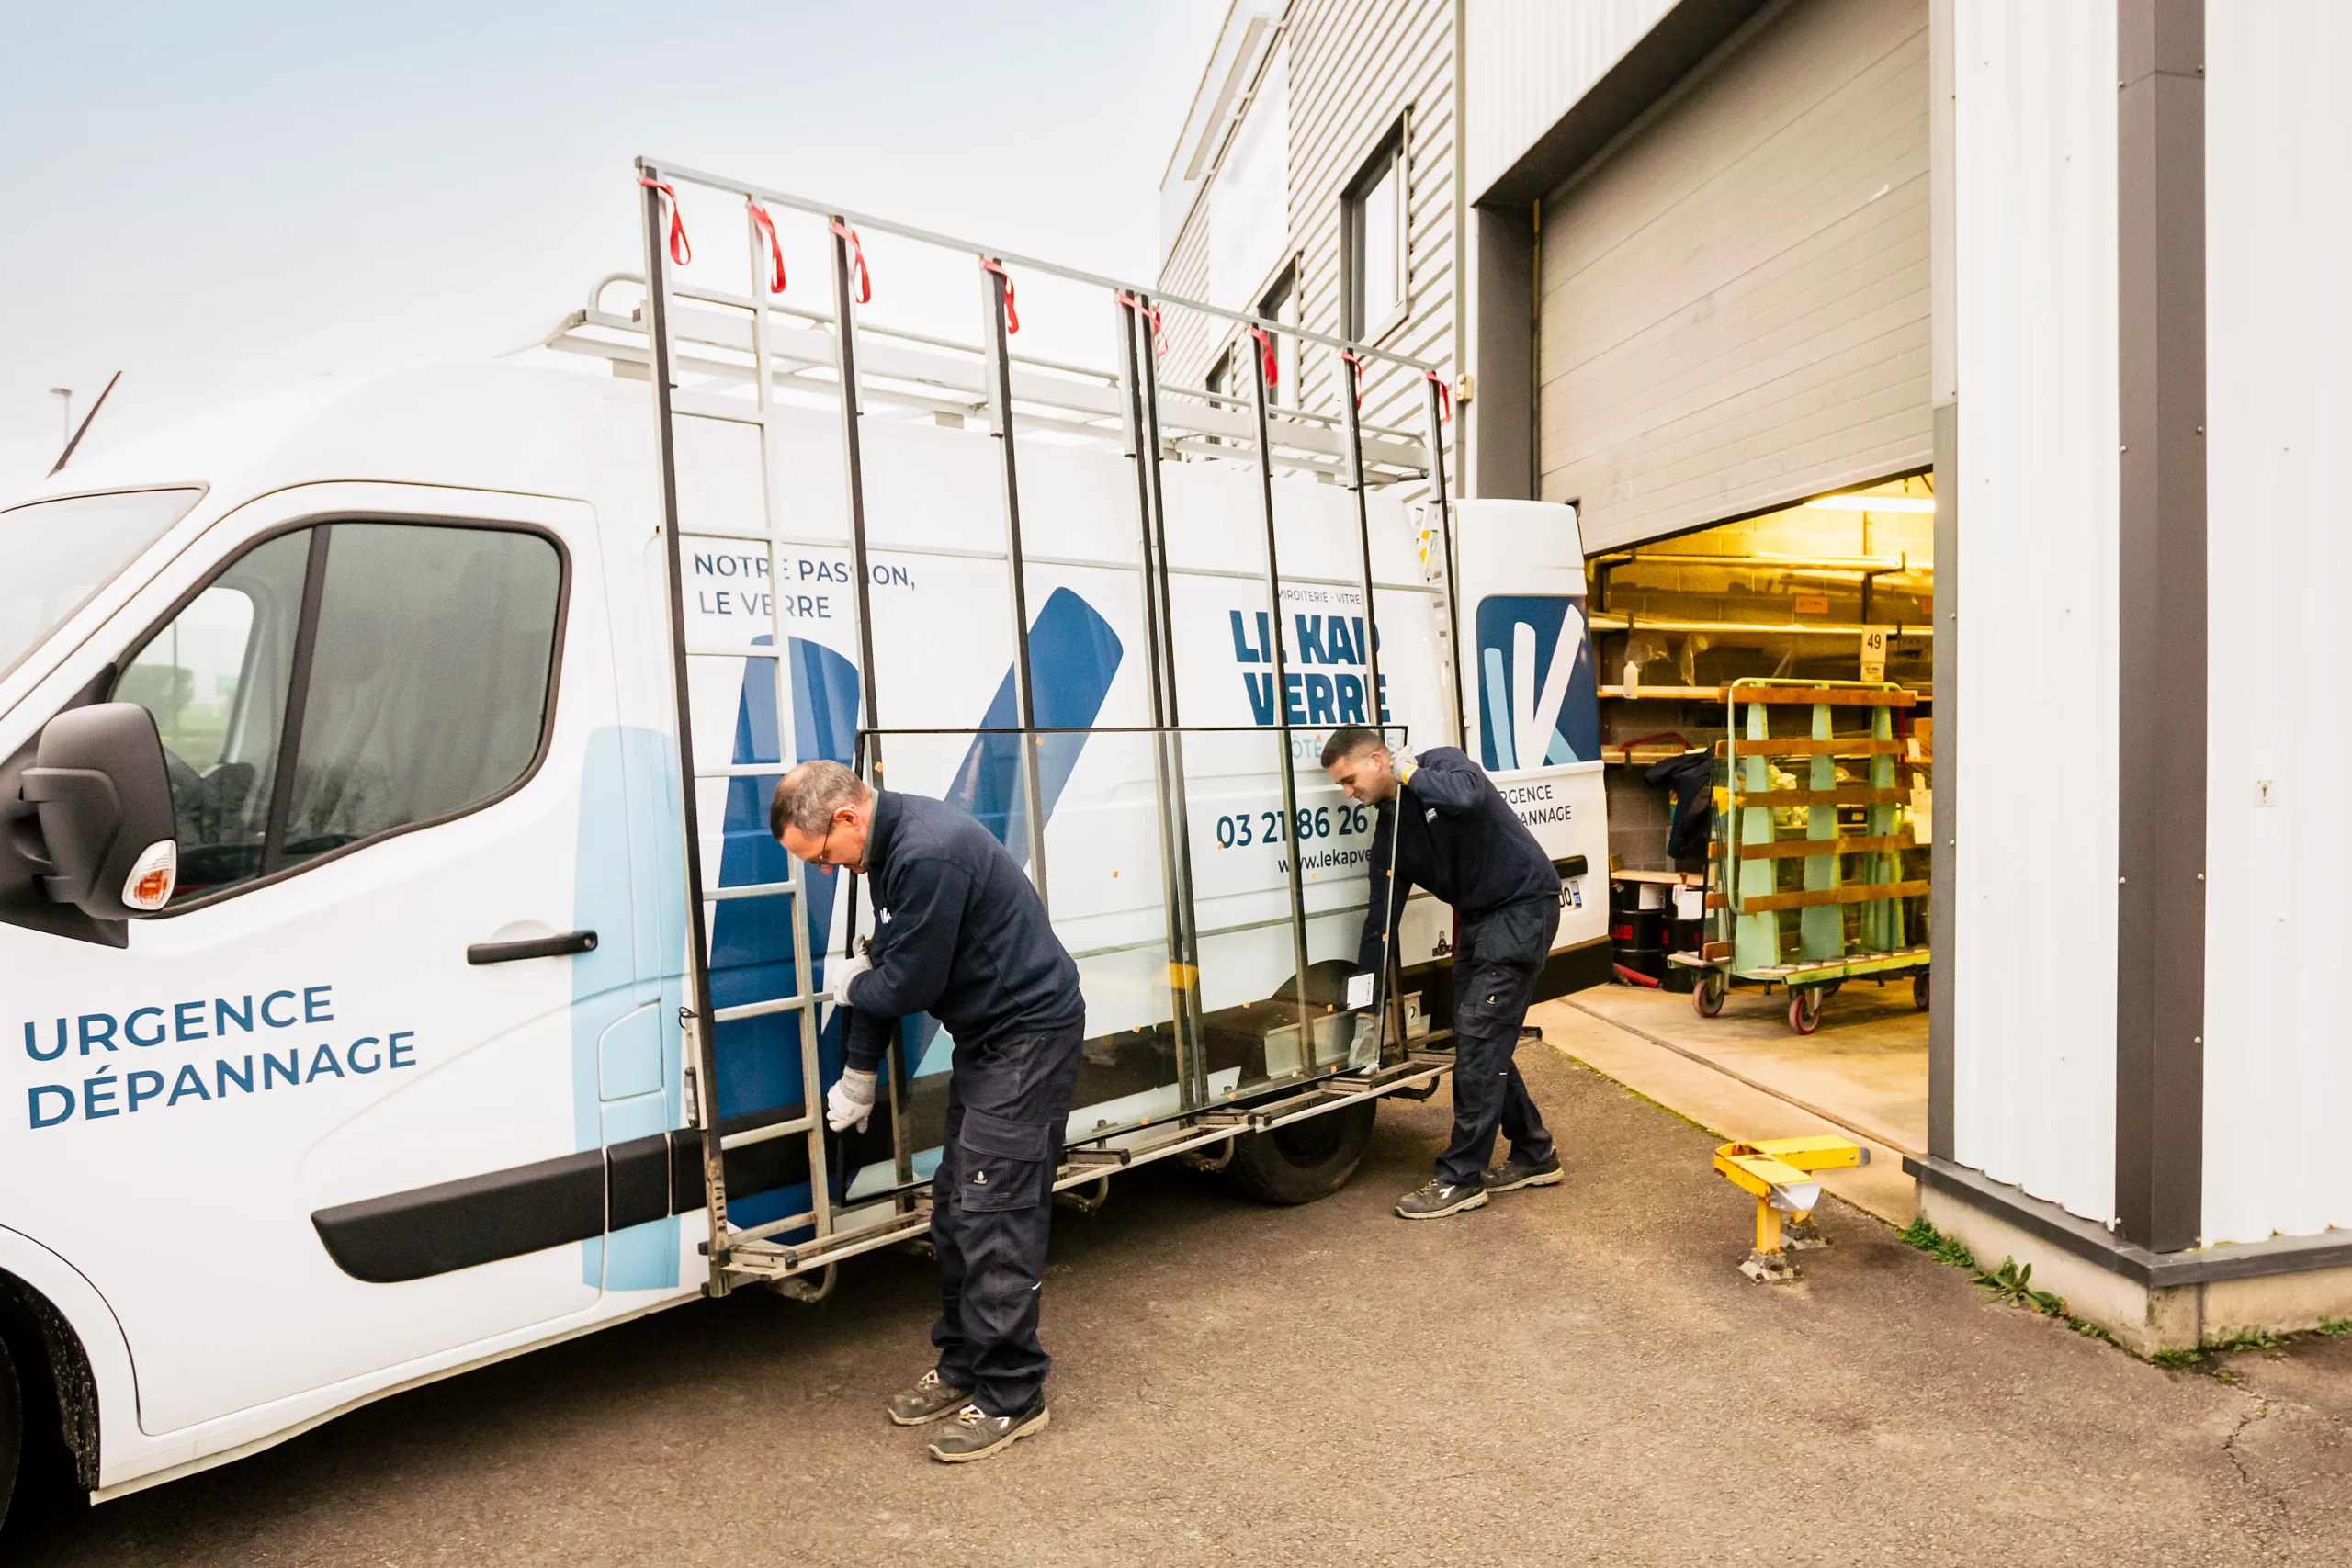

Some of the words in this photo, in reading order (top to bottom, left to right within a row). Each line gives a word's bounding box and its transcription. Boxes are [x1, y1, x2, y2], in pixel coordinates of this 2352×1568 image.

[798, 559, 915, 591] PASON,
[699, 591, 732, 615] LE
[740, 592, 831, 617] VERRE
[1867, 633, 1881, 649] 49
[1243, 672, 1391, 726] VERRE
[1216, 814, 1252, 849] 03
[1261, 810, 1287, 843] 21
[1296, 807, 1330, 840] 86
[1337, 804, 1368, 835] 26
[24, 985, 334, 1062] URGENCE
[28, 1031, 417, 1130] DÉPANNAGE
